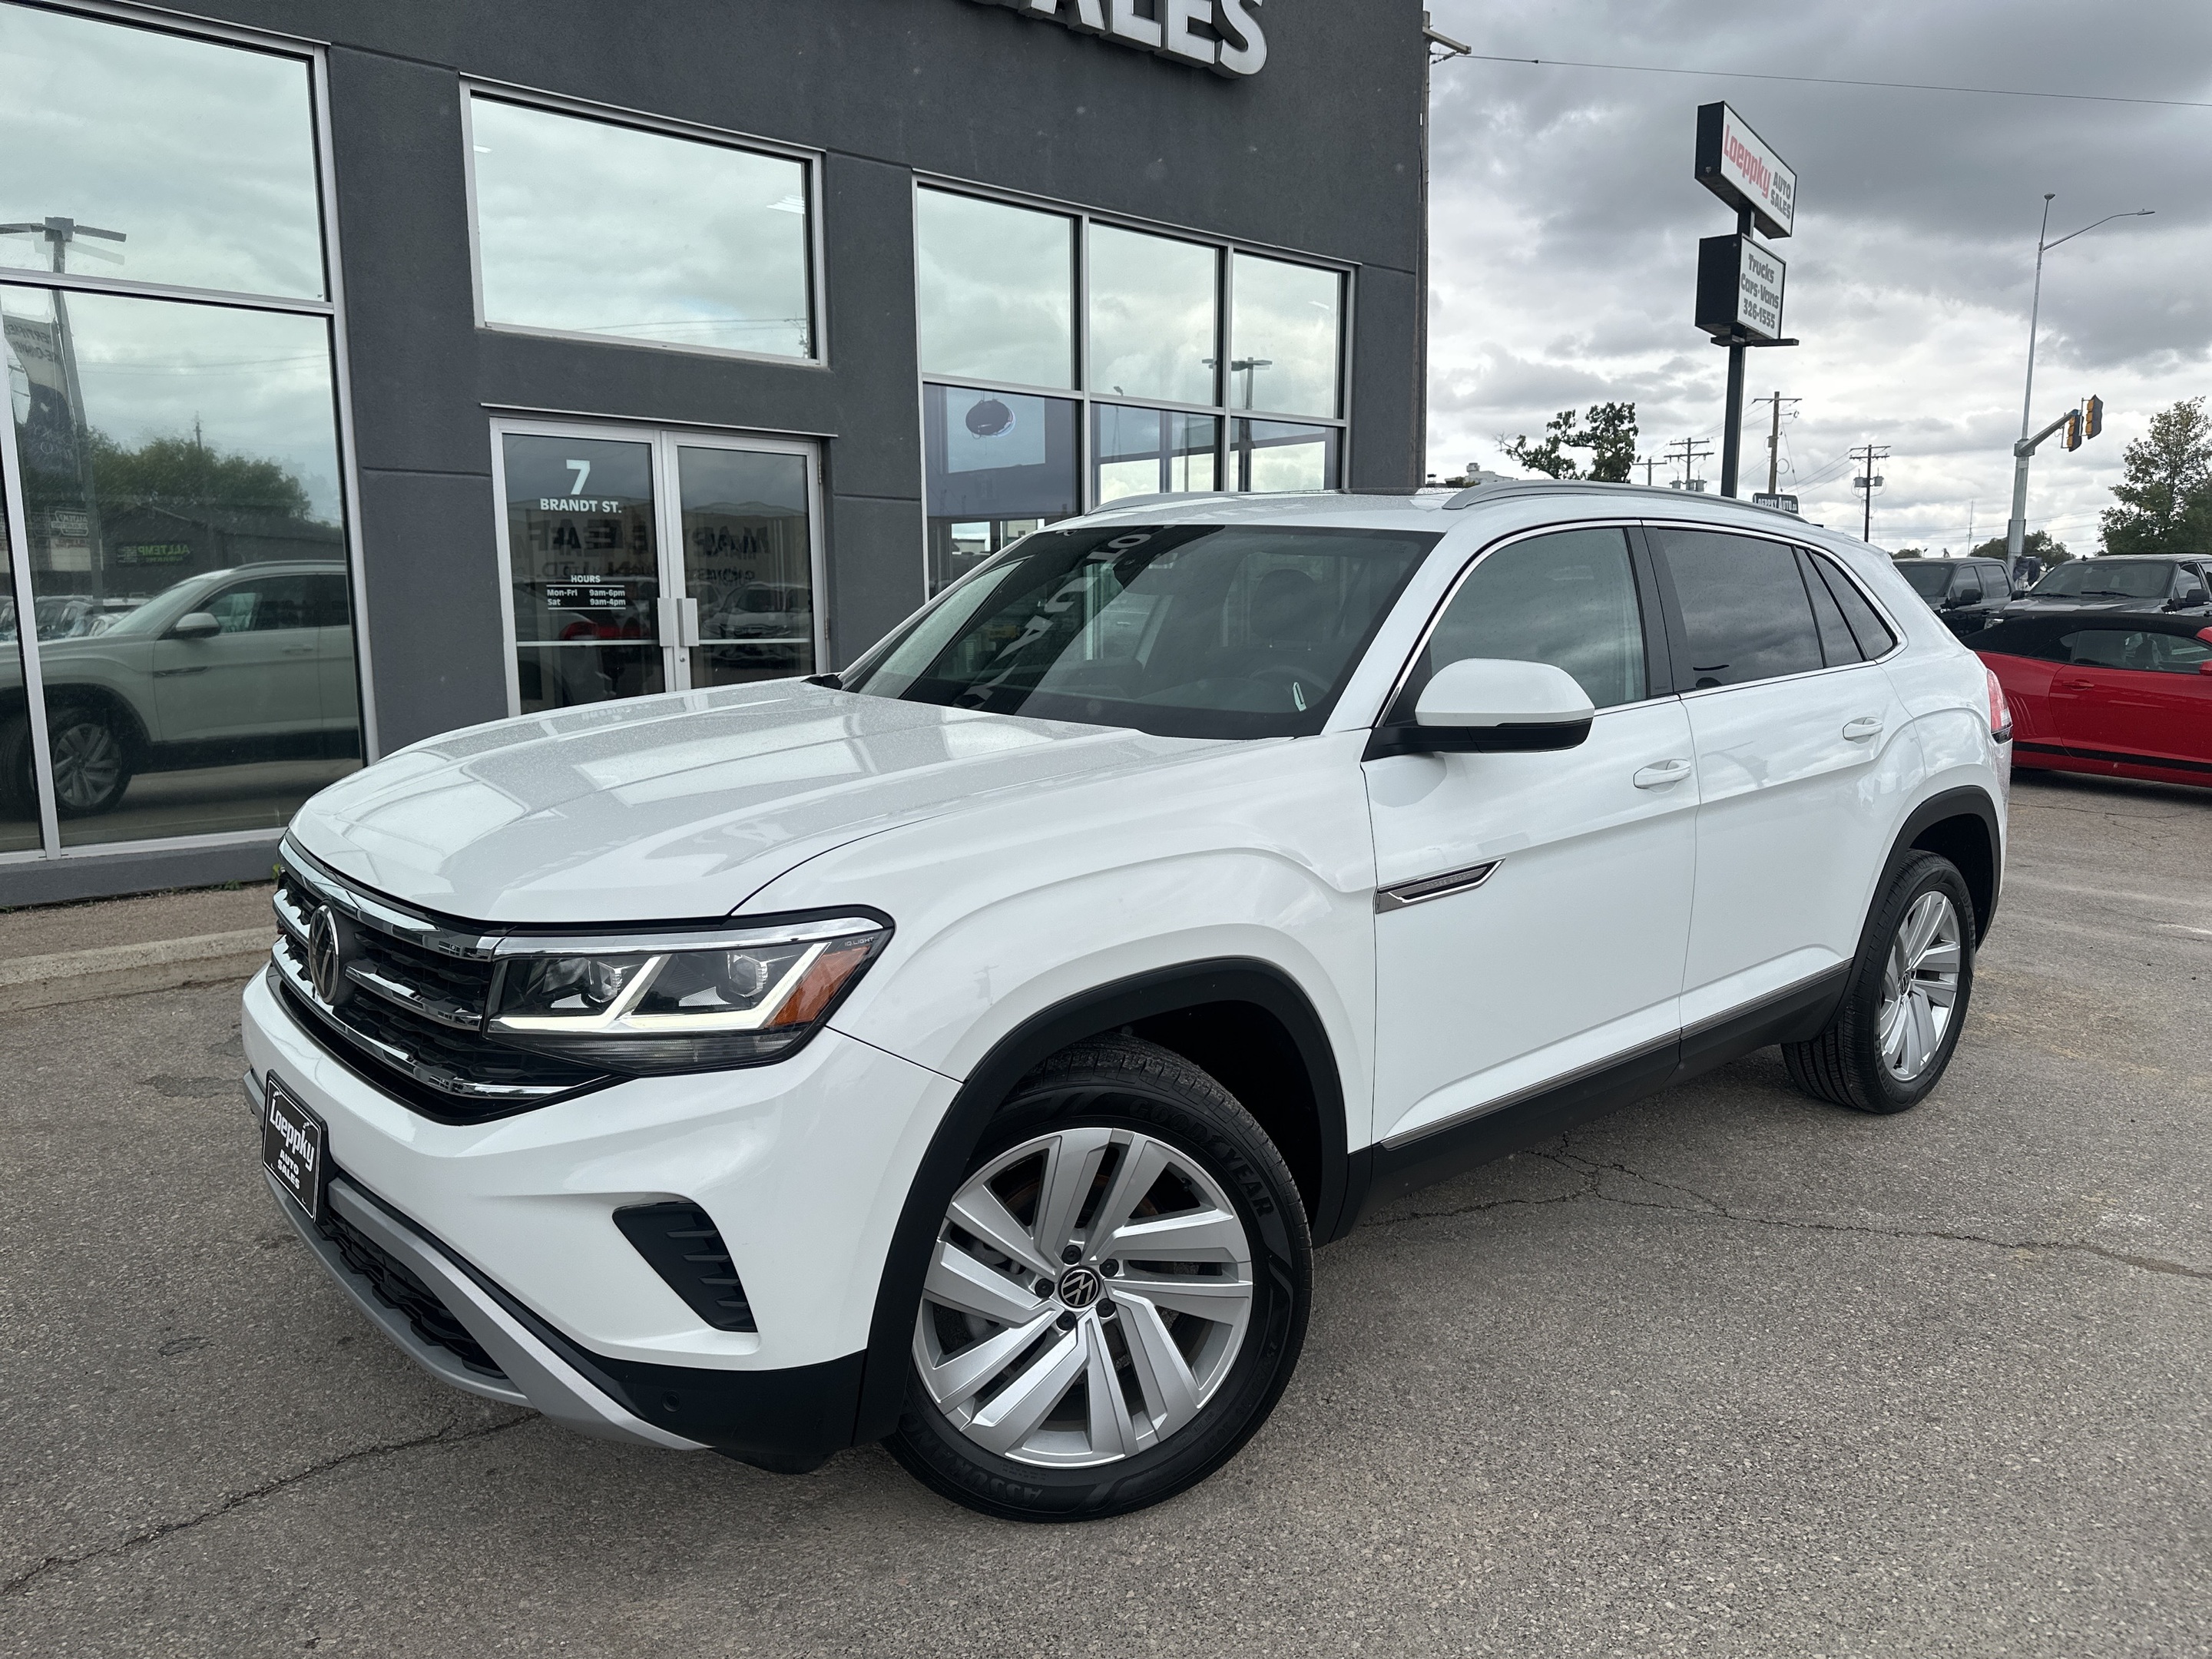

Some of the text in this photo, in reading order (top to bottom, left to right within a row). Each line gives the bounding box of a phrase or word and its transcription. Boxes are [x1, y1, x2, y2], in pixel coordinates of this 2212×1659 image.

[998, 0, 1267, 75] LES
[1724, 124, 1771, 199] Loeppky
[1773, 171, 1791, 200] AUTO
[1770, 188, 1791, 220] SALES
[1748, 253, 1774, 283] Trucks
[566, 459, 591, 495] 7
[540, 498, 622, 513] BRANDT ST.
[571, 575, 601, 583] HOURS
[589, 589, 625, 598] 9am-6pm
[590, 598, 626, 607] 9am-4pm
[844, 936, 874, 947] IQ.LIGHT
[270, 1098, 315, 1172] Loeppky
[280, 1149, 300, 1175] AUTO
[1129, 1098, 1276, 1217] GOODYEAR
[277, 1158, 300, 1190] SALES
